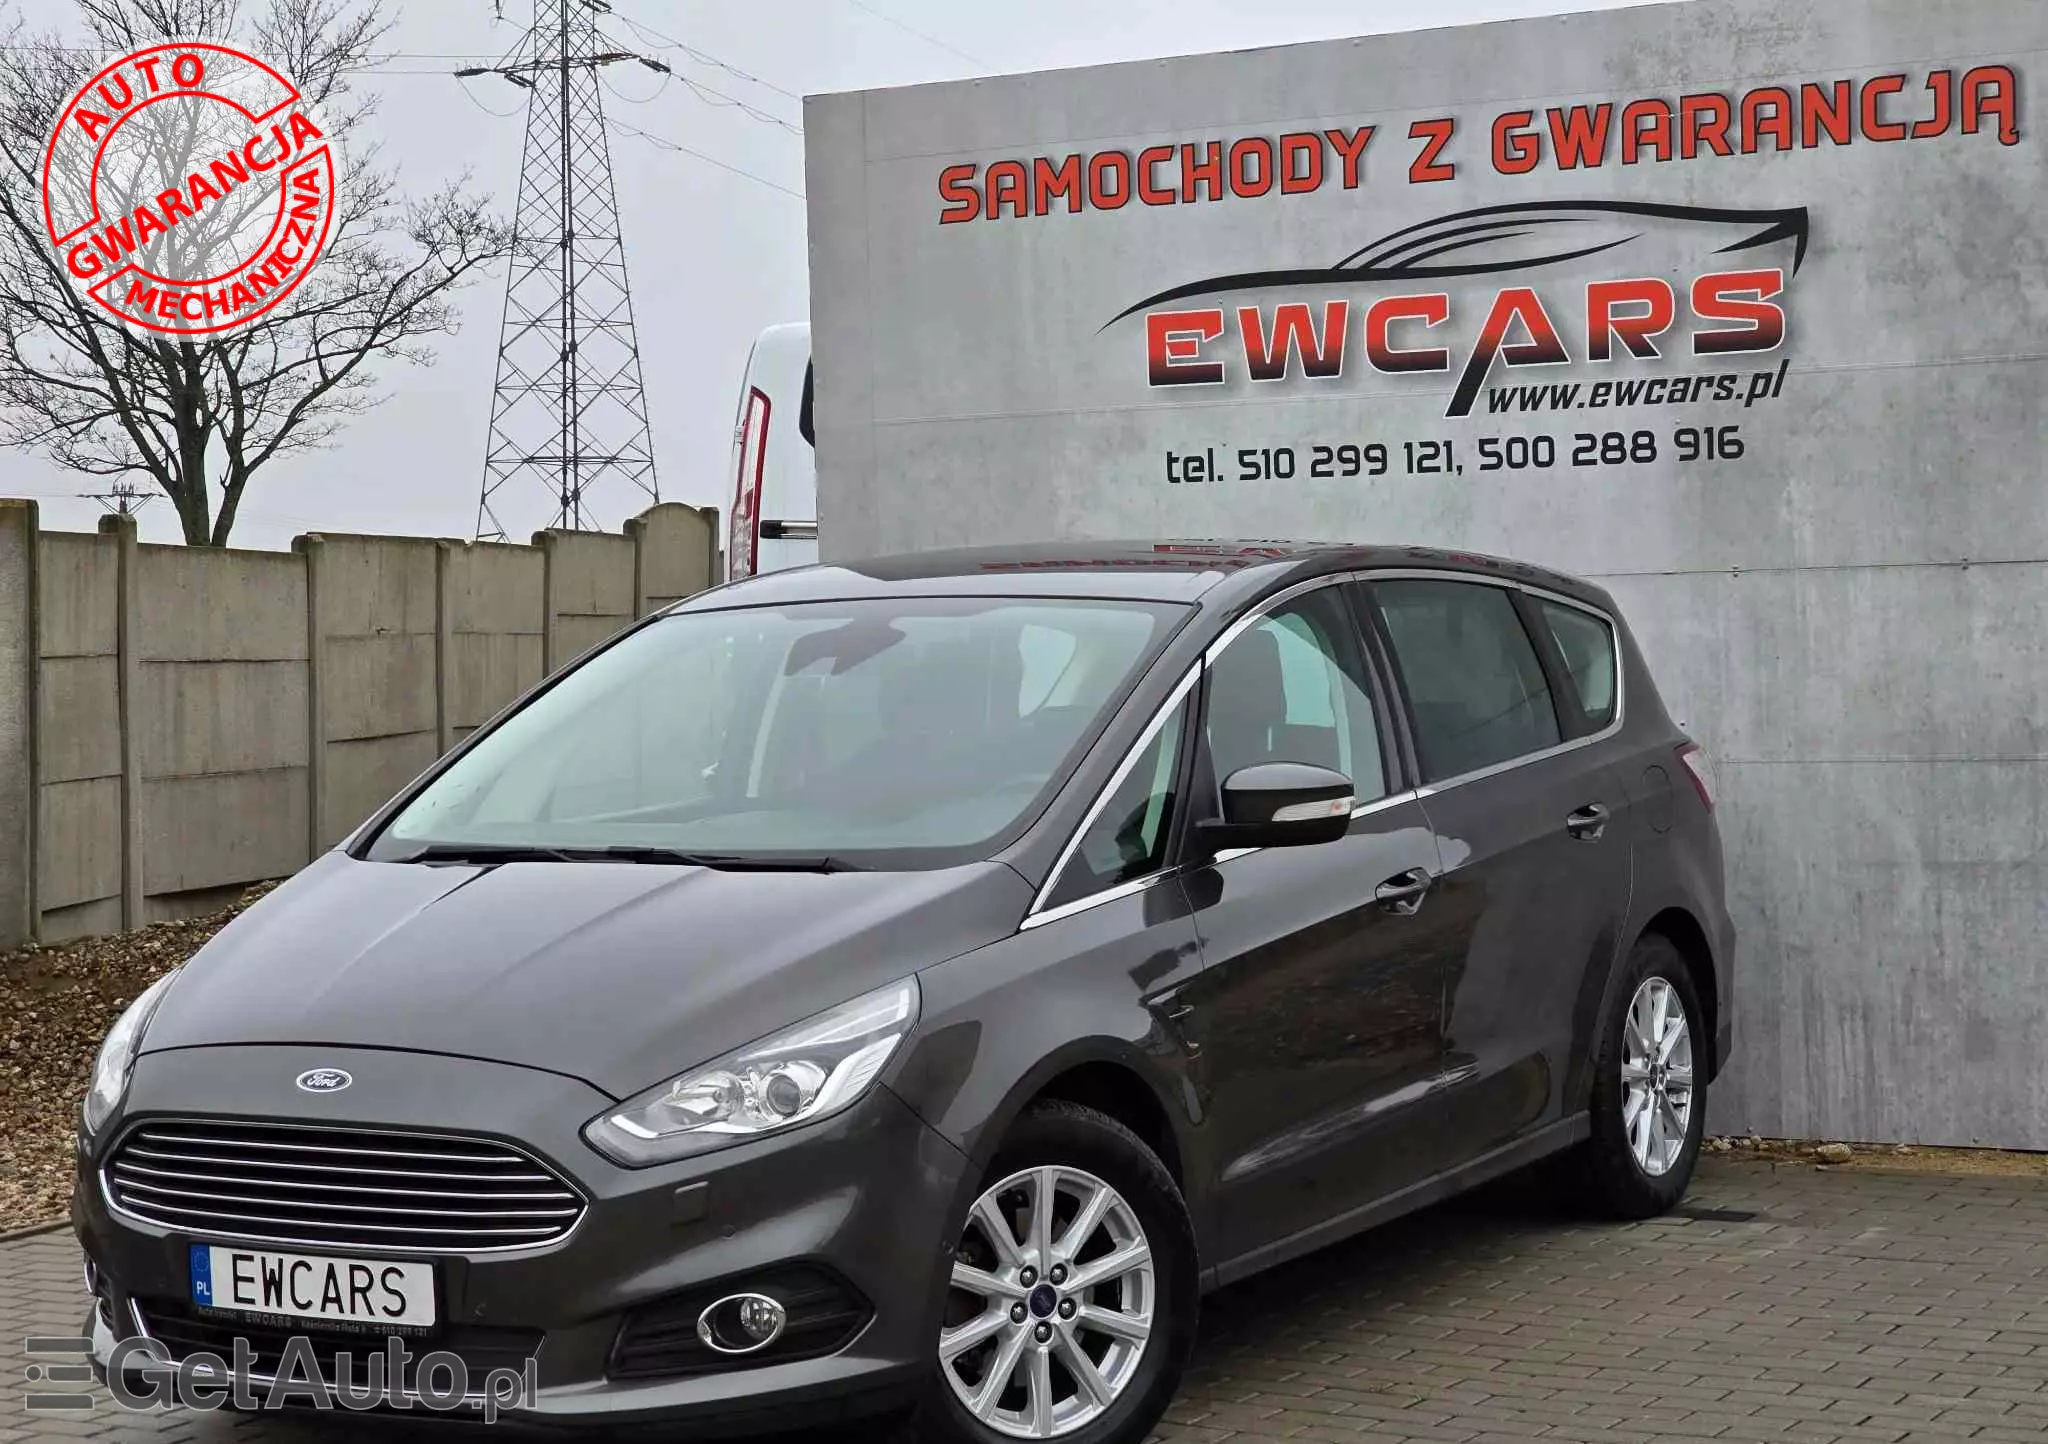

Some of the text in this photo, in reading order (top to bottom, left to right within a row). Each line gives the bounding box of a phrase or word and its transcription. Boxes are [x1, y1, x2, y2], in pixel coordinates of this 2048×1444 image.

[938, 64, 2021, 225] SAMOCHODY Z GWARANCJĄ
[1145, 268, 1786, 418] EWCARS
[1488, 358, 1791, 414] www.ewcars.pl
[1166, 425, 1745, 484] tel. 510 299 121, 500 288 916
[307, 1073, 341, 1087] Ford
[196, 1281, 210, 1296] PL
[232, 1253, 407, 1317] EWCARS
